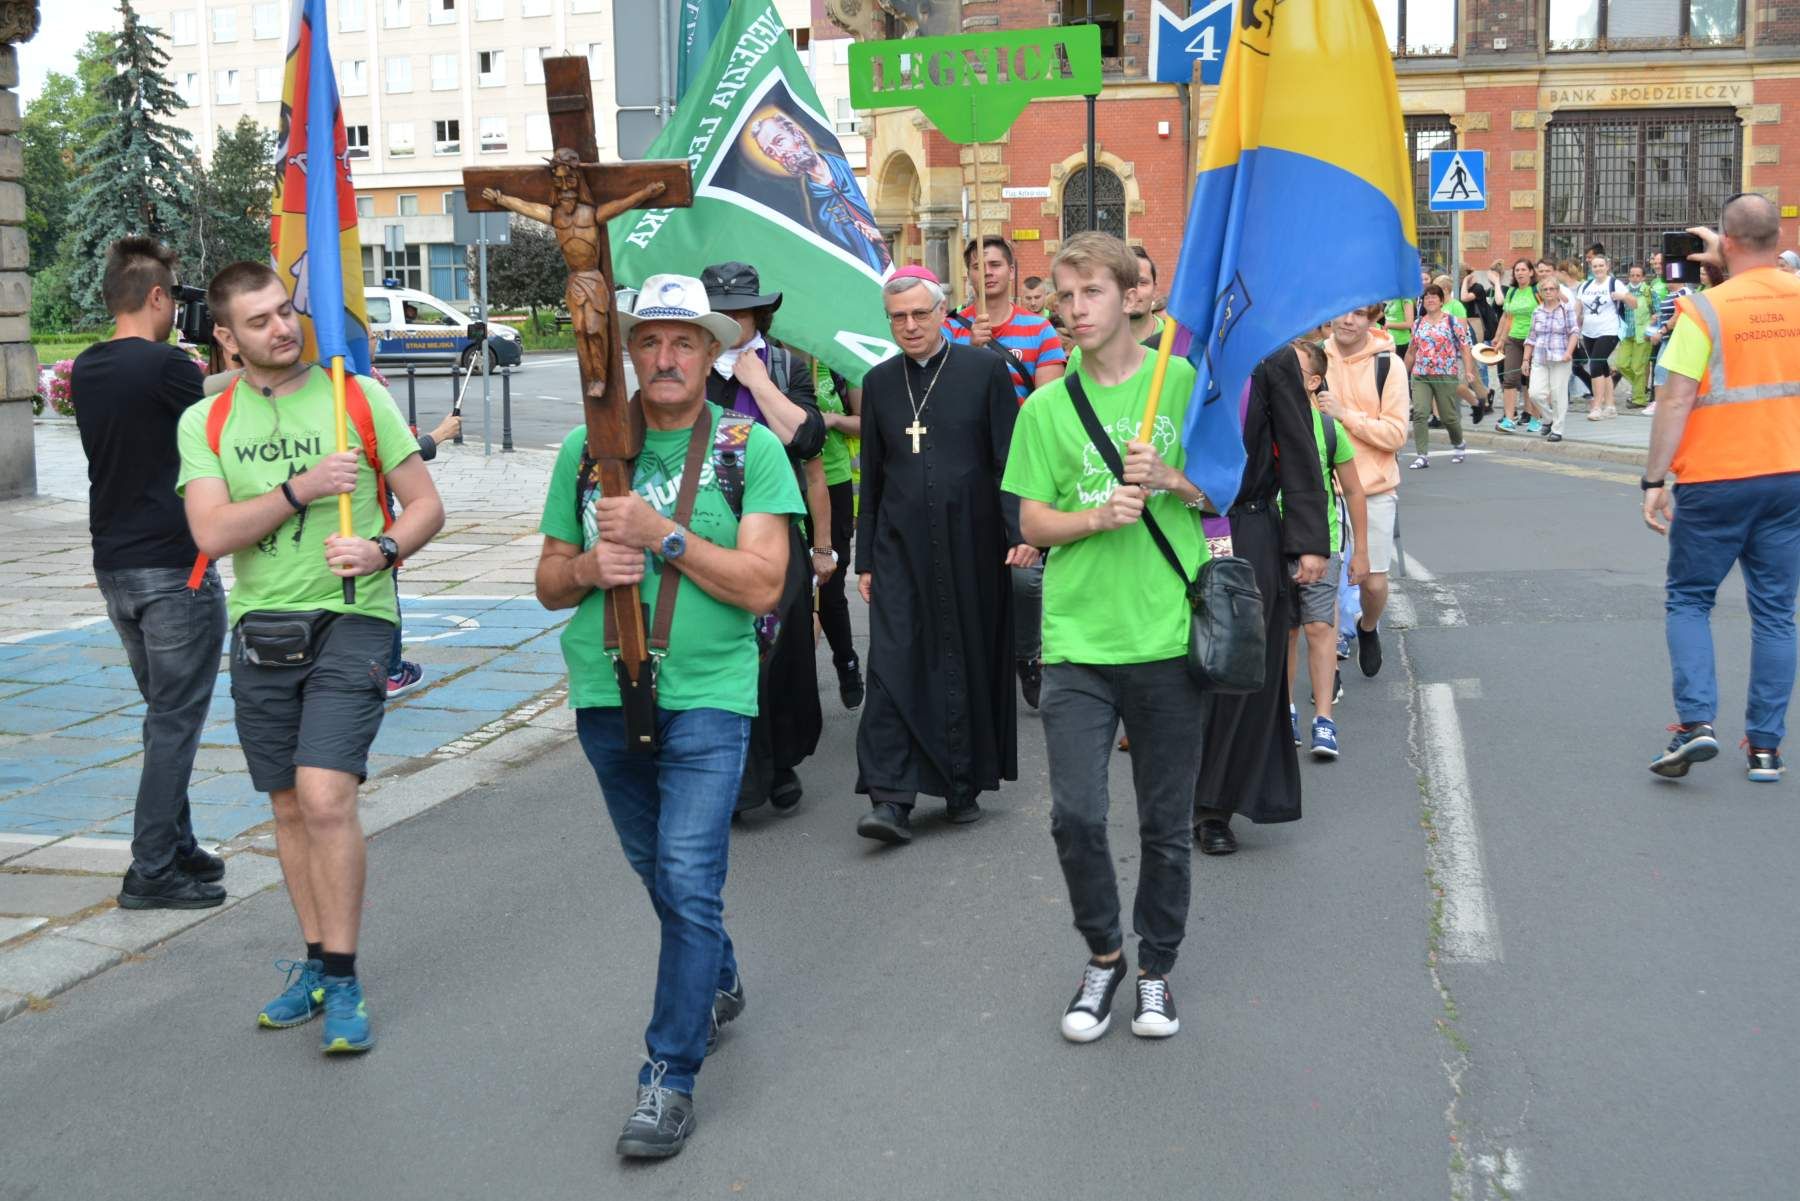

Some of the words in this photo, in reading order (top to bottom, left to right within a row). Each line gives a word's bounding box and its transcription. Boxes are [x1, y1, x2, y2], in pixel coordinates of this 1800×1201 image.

[1184, 26, 1221, 61] 4
[871, 42, 1075, 93] LEGNICA
[1550, 89, 1597, 103] BANK
[234, 437, 321, 464] WOLNI
